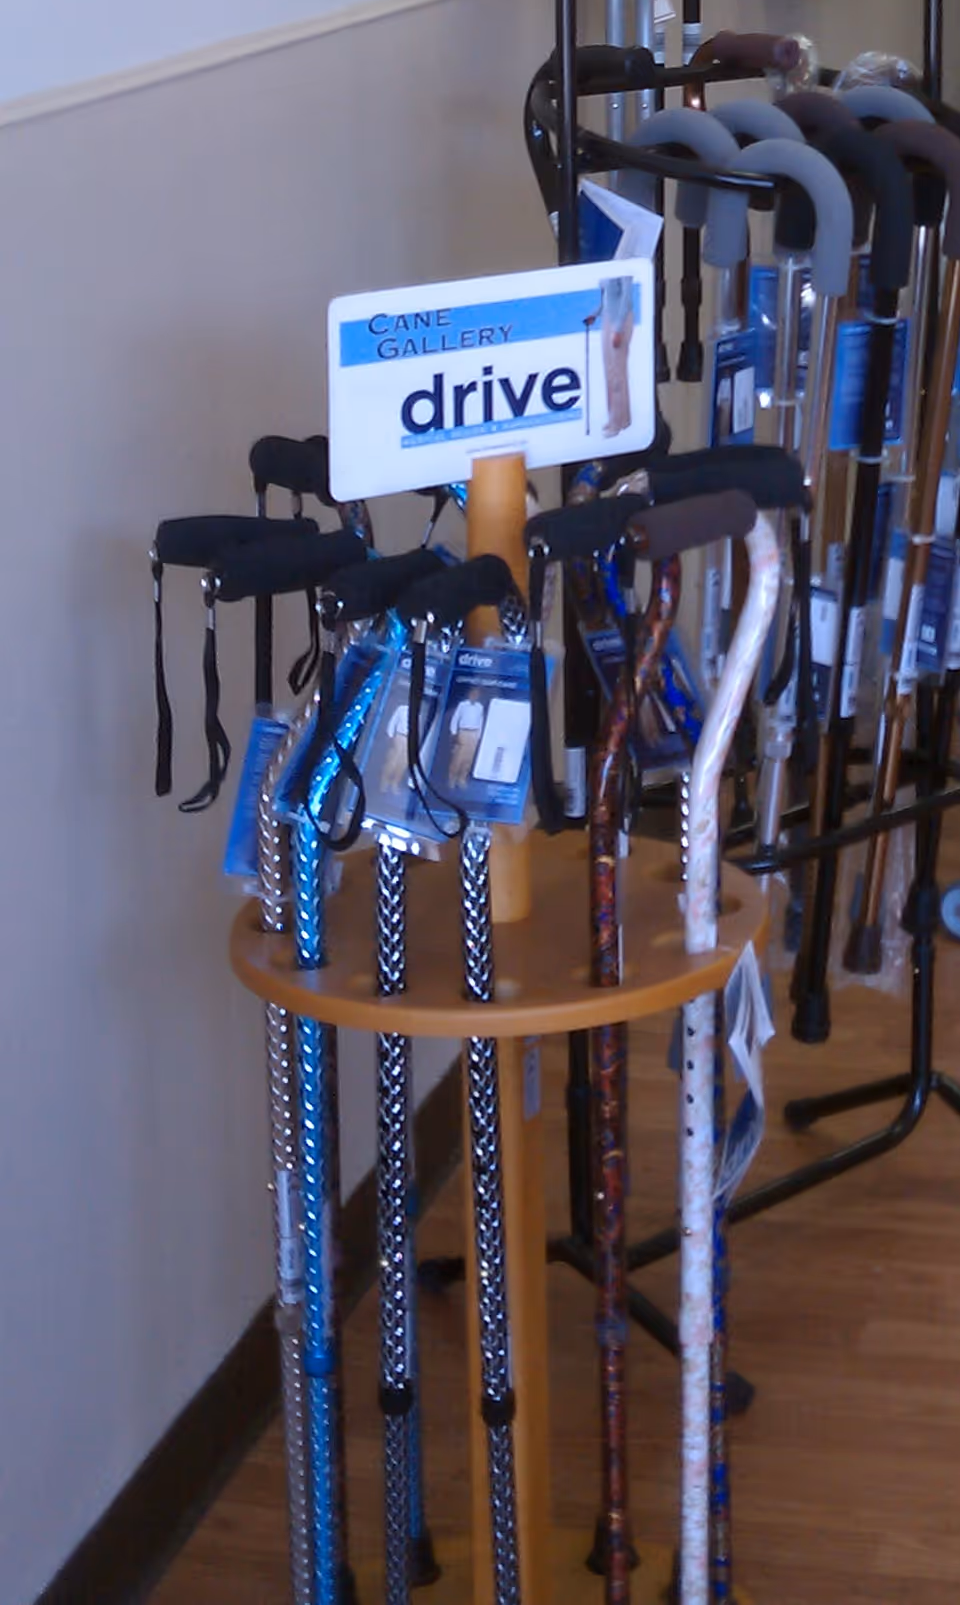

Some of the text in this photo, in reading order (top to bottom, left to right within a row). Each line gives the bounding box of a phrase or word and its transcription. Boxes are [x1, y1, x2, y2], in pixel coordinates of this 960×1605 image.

[367, 308, 452, 336] CANE
[376, 324, 514, 360] GALLERY
[400, 365, 582, 435] drive
[458, 654, 494, 668] drive
